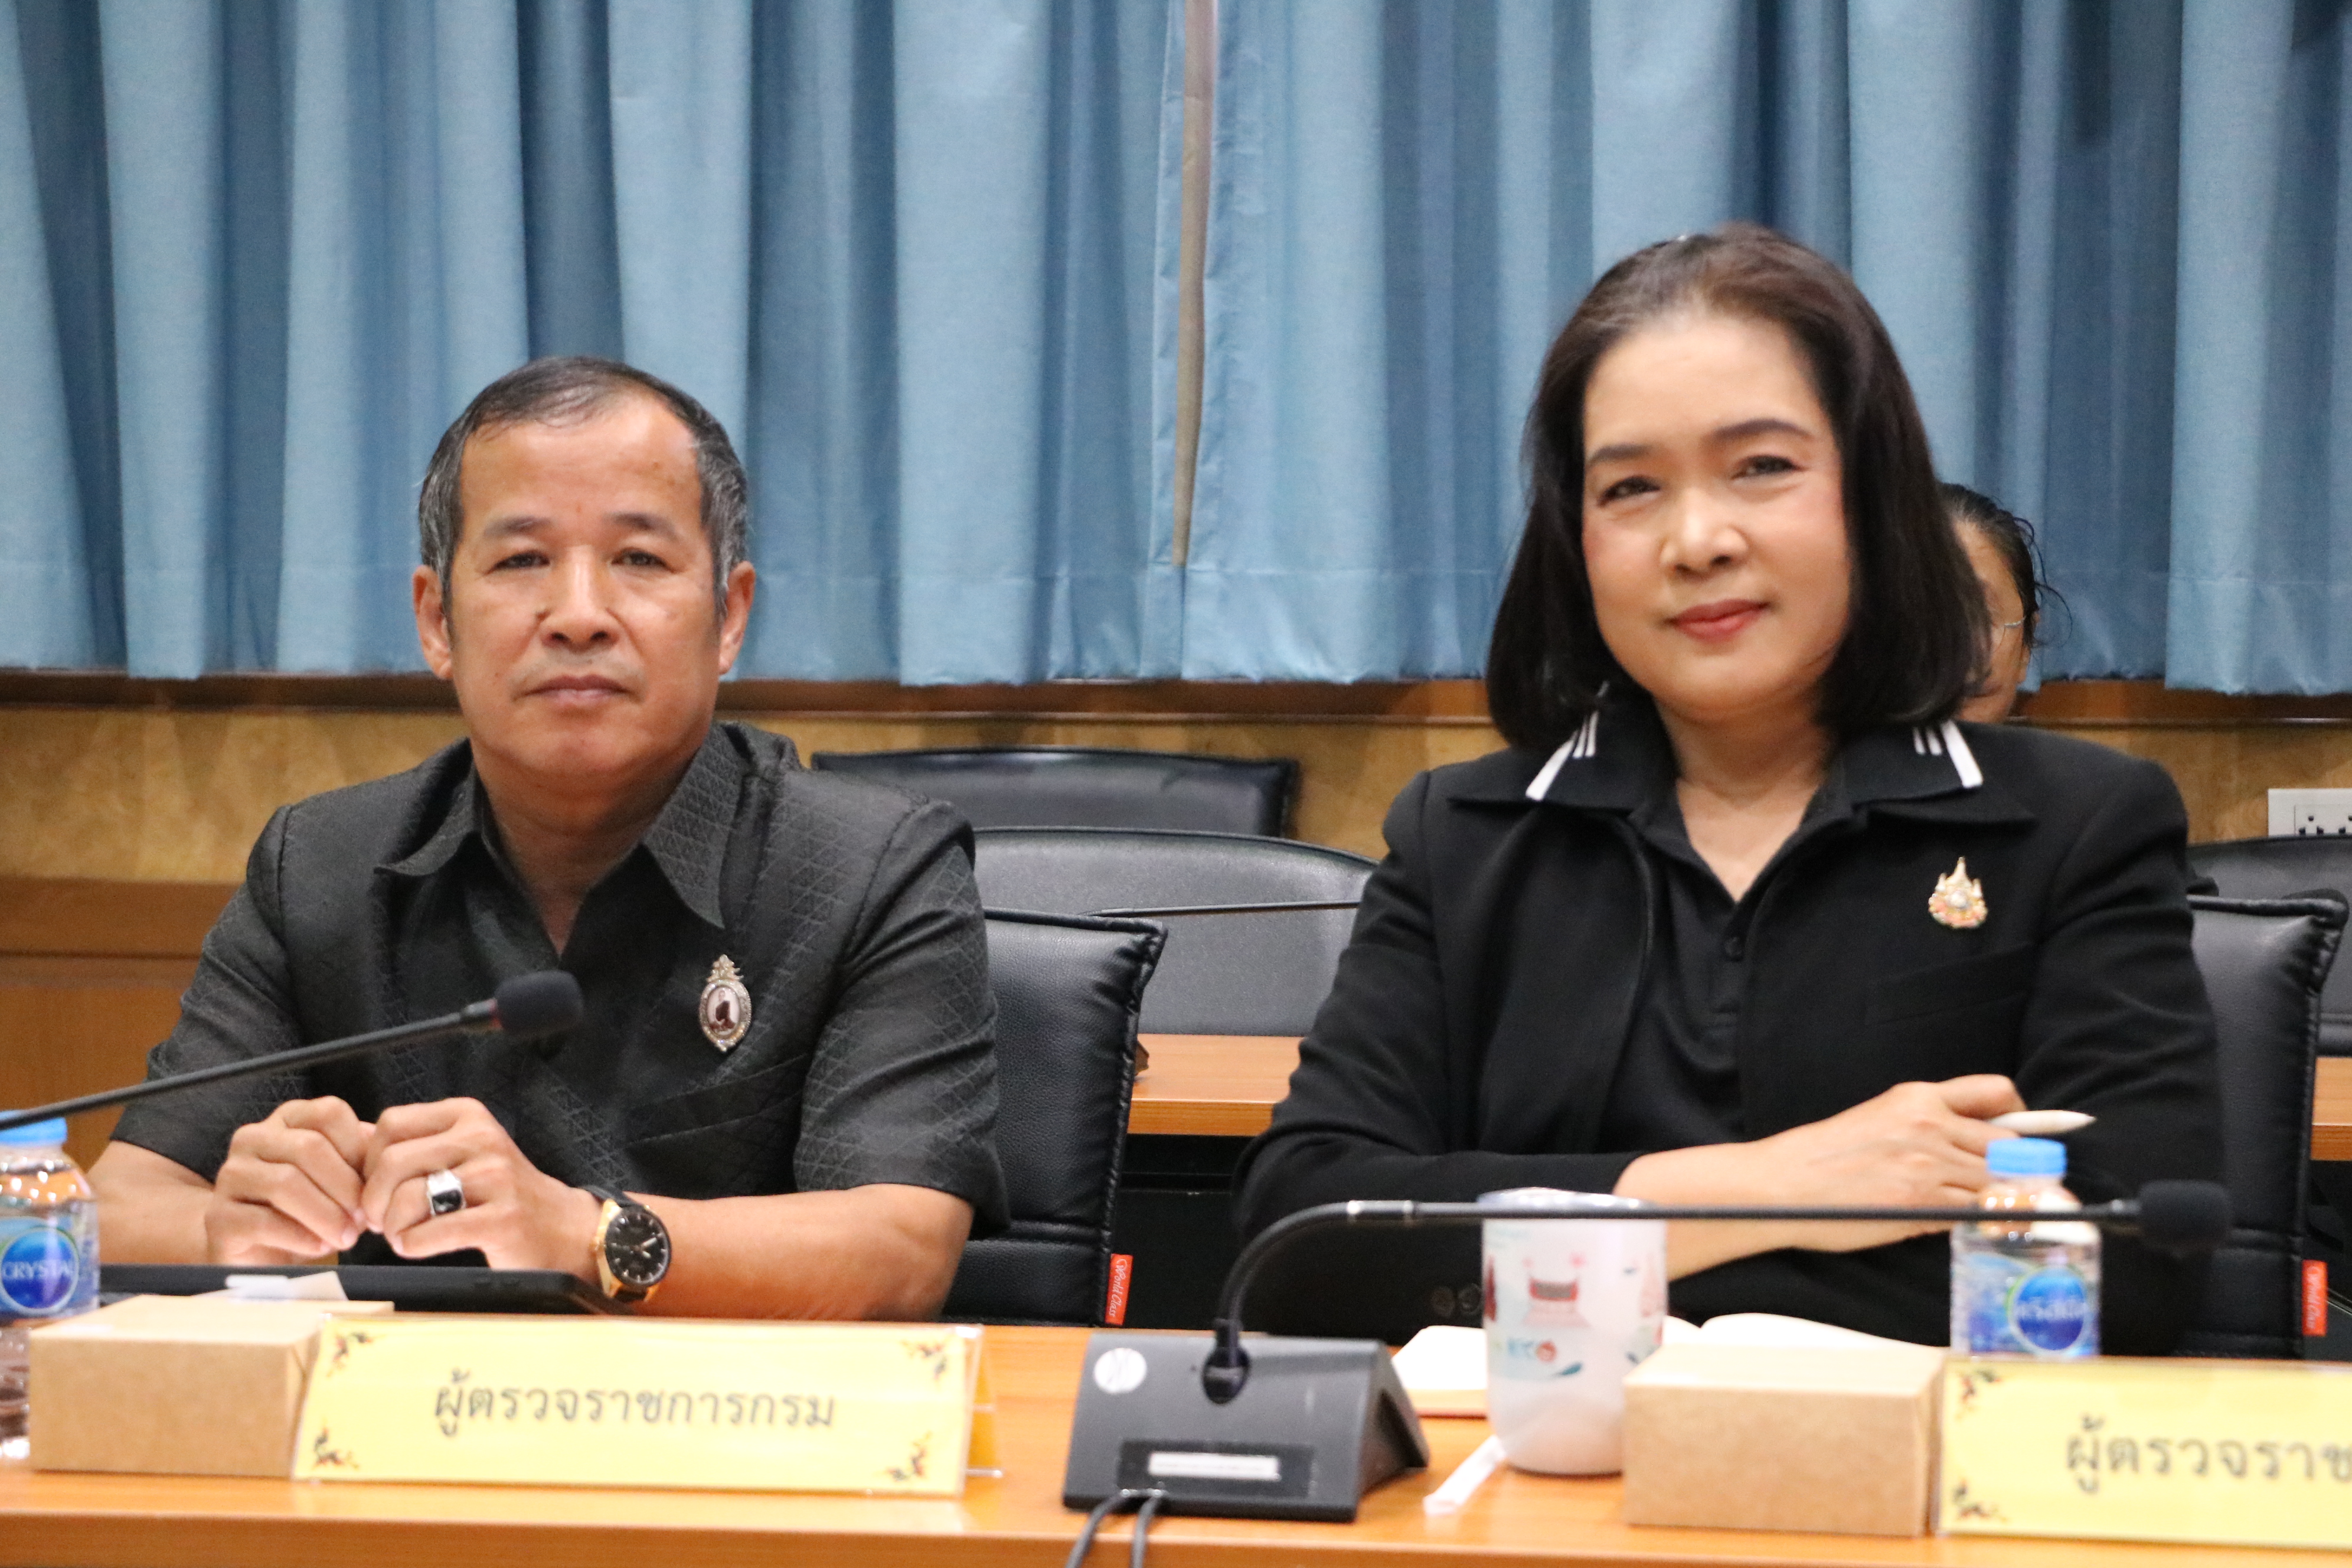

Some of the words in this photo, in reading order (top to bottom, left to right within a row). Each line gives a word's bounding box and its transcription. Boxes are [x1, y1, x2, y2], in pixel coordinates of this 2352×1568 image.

[434, 1368, 835, 1438] ผู้ตรวจราชการกรม
